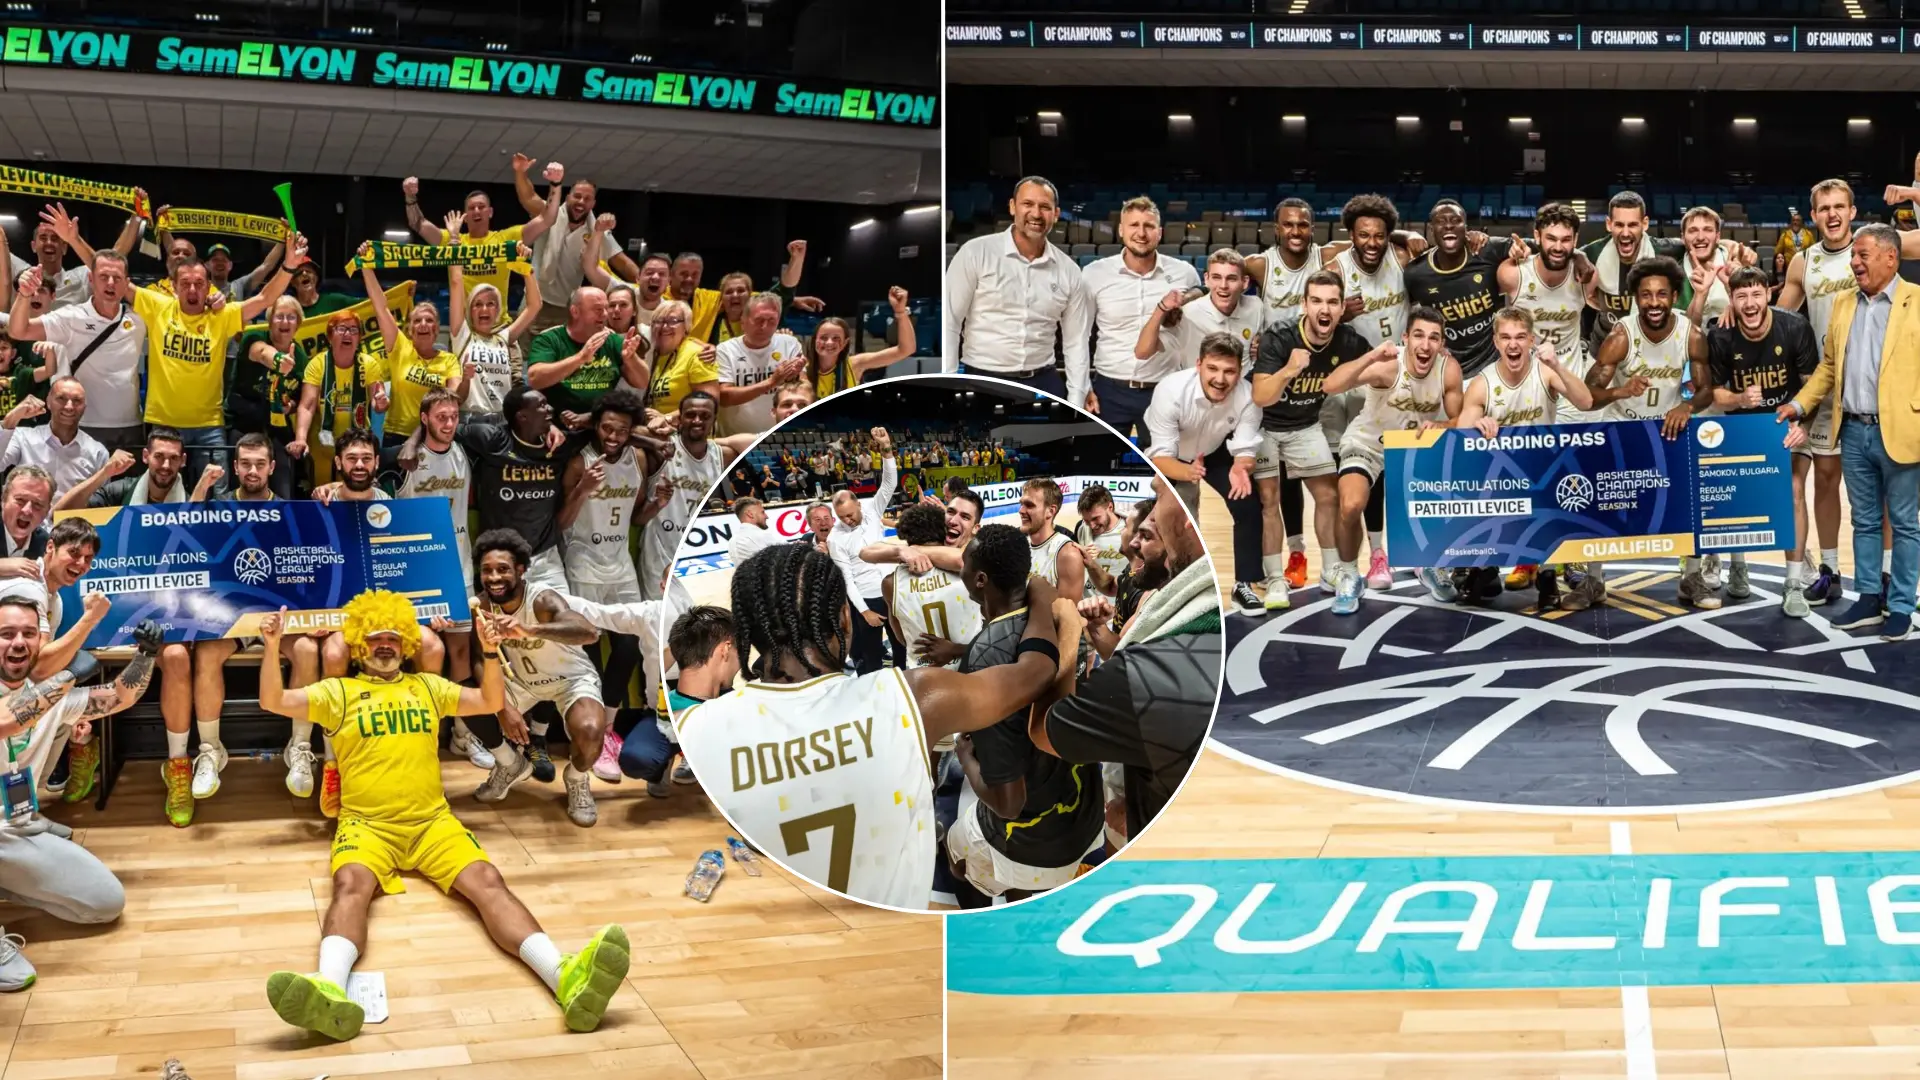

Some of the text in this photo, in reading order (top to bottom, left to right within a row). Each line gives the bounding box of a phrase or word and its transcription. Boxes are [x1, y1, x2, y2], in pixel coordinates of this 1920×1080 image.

[947, 26, 1002, 40] CHAMPIONS
[1045, 27, 1112, 41] OF CHAMPIONS
[1155, 27, 1222, 41] OF CHAMPIONS
[1265, 28, 1332, 42] OF CHAMPIONS
[1374, 29, 1441, 43] OF CHAMPIONS
[1483, 29, 1550, 44] OF CHAMPIONS
[1591, 30, 1658, 44] OF CHAMPIONS
[1700, 31, 1765, 45] OF CHAMPIONS
[1807, 31, 1872, 46] OF CHAMPIONS
[0, 27, 129, 67] ELYON
[156, 37, 356, 81] SamELYON
[373, 52, 560, 95] SamELYON
[582, 68, 756, 110] SamELYON
[775, 83, 935, 124] SamELYON
[177, 213, 278, 234] BASKETBAL LEVICE
[435, 246, 453, 260] ZA
[457, 243, 507, 259] LEVICE
[1441, 293, 1495, 322] EVICE
[1604, 295, 1633, 310] LEV
[1379, 317, 1392, 338] 5
[164, 332, 211, 356] LEVICE
[1540, 328, 1561, 345] 75
[1464, 432, 1606, 451] BOARDING PASS
[1596, 469, 1662, 481] BASKETBALL
[1740, 467, 1780, 476] BULGARIA
[1408, 478, 1530, 493] CONGRATULATIONS
[1597, 478, 1671, 491] CHAMPIONS
[1700, 485, 1737, 495] REGULAR
[981, 487, 1022, 502] ALEON
[1597, 490, 1637, 500] LEAGUE
[1700, 493, 1732, 502] SEASON
[1414, 500, 1525, 516] PATRIOTI LEVICE
[1598, 501, 1638, 511] SEASON X
[141, 508, 281, 527] BOARDING PASS
[610, 506, 620, 526] 5
[273, 546, 336, 556] BASKETBALL
[409, 543, 447, 553] BULGARIA
[1444, 548, 1498, 556] #BasketballCL
[1583, 539, 1674, 557] QUALIFIED
[90, 551, 208, 570] ONGRATULATIONS
[274, 554, 345, 566] CHAMPIONS
[372, 561, 408, 571] REGULAR
[275, 565, 315, 575] LEAGUE
[373, 570, 404, 579] SEASON
[86, 573, 204, 593] PATRIOTI LEVICE
[276, 576, 315, 585] SEASON X
[910, 572, 951, 593] McGILL
[287, 612, 350, 629] ALIFIE
[922, 601, 952, 641] 0
[358, 708, 432, 738] LEVICE
[731, 717, 874, 793] DORSEY
[780, 803, 857, 895] 7
